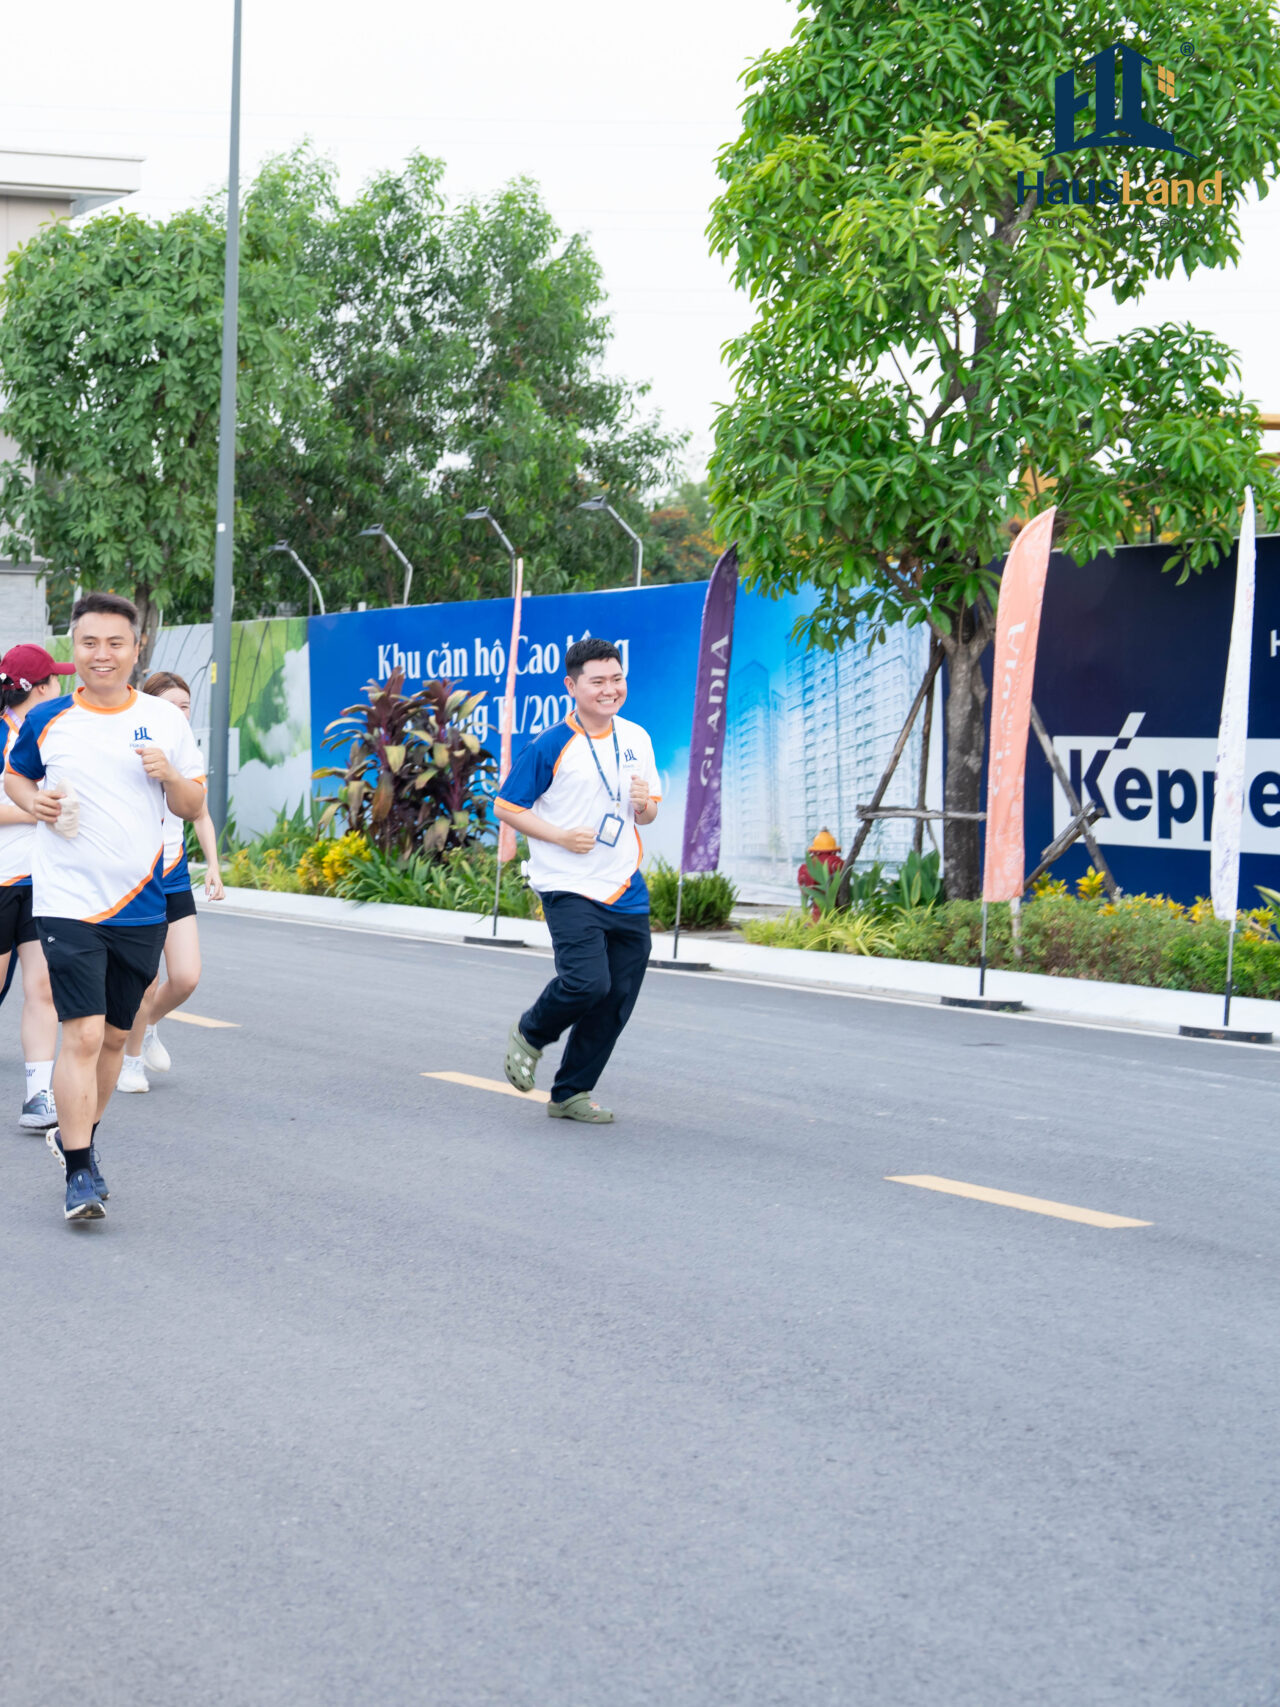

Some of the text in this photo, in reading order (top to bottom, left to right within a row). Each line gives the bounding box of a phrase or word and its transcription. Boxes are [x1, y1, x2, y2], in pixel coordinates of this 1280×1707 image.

[378, 642, 421, 681] Khu
[426, 641, 468, 679] căn
[474, 637, 506, 684] hộ
[515, 635, 560, 676] Cao
